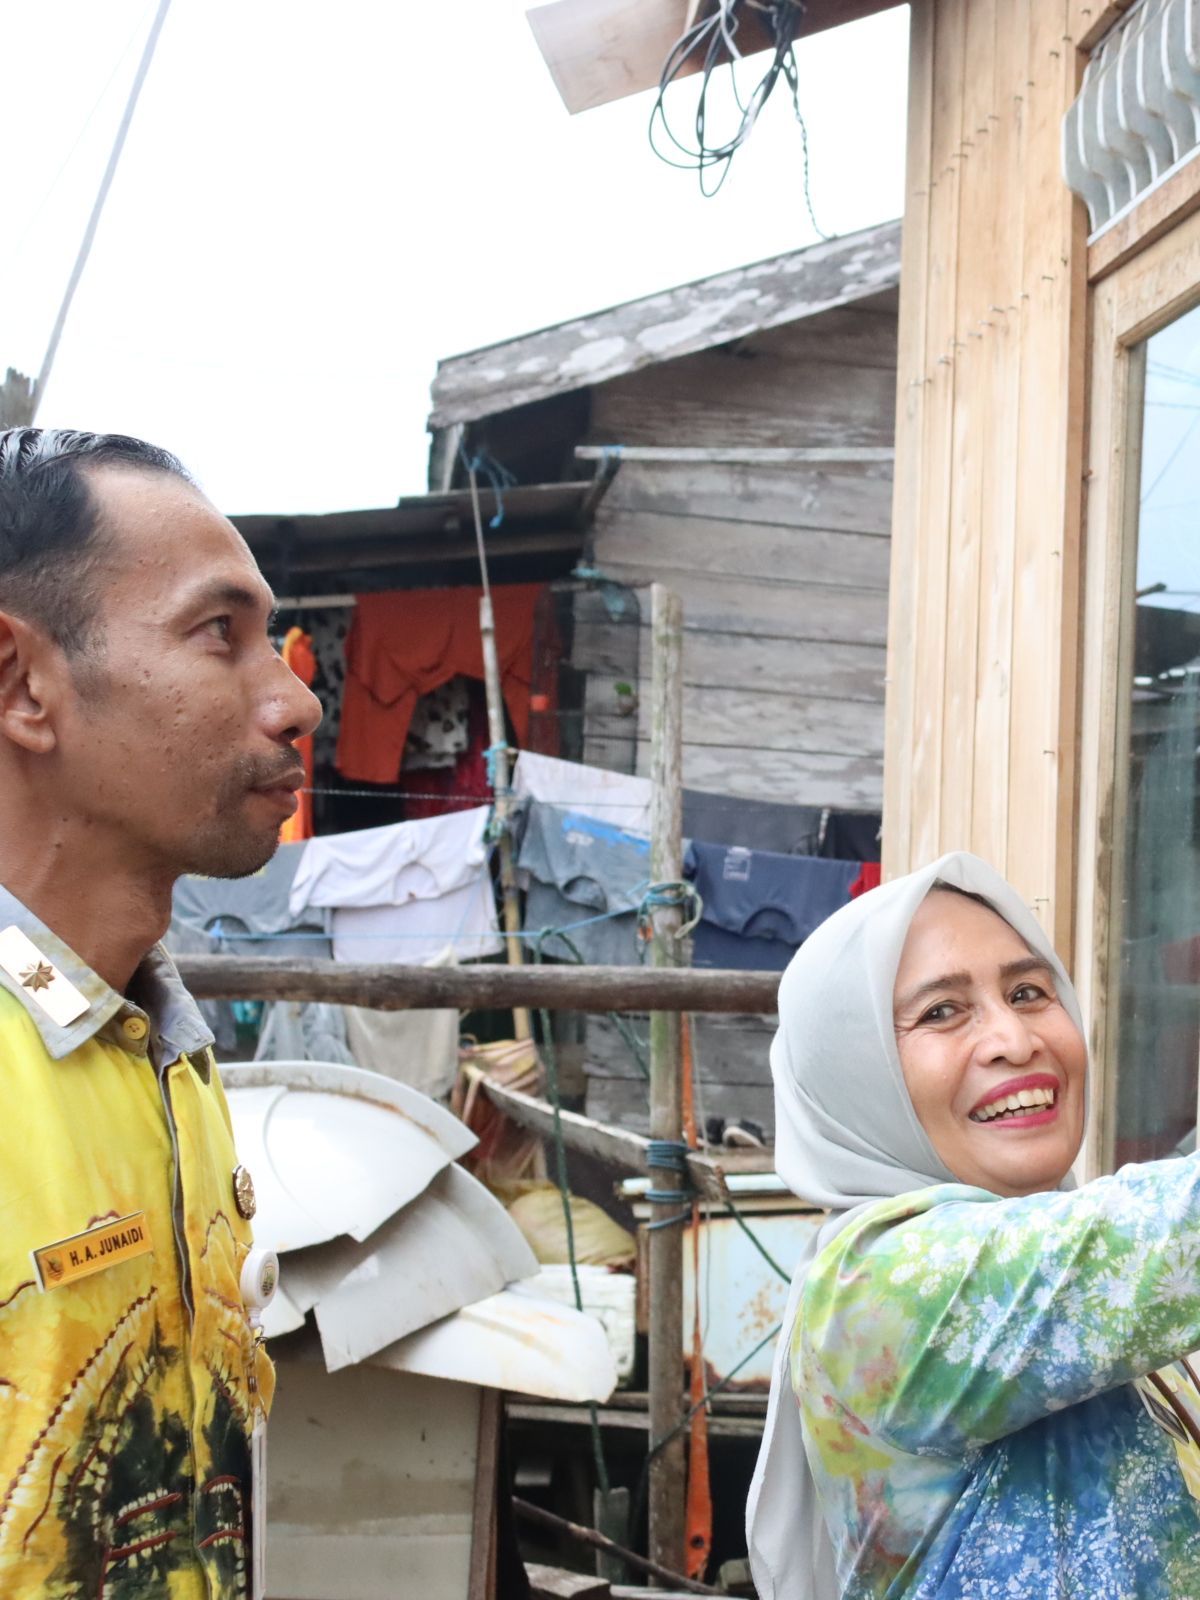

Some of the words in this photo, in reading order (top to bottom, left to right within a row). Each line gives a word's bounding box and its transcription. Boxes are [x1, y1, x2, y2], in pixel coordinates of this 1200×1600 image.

[69, 1250, 84, 1267] H.
[85, 1246, 98, 1262] A.
[99, 1226, 144, 1256] JUNAIDI
